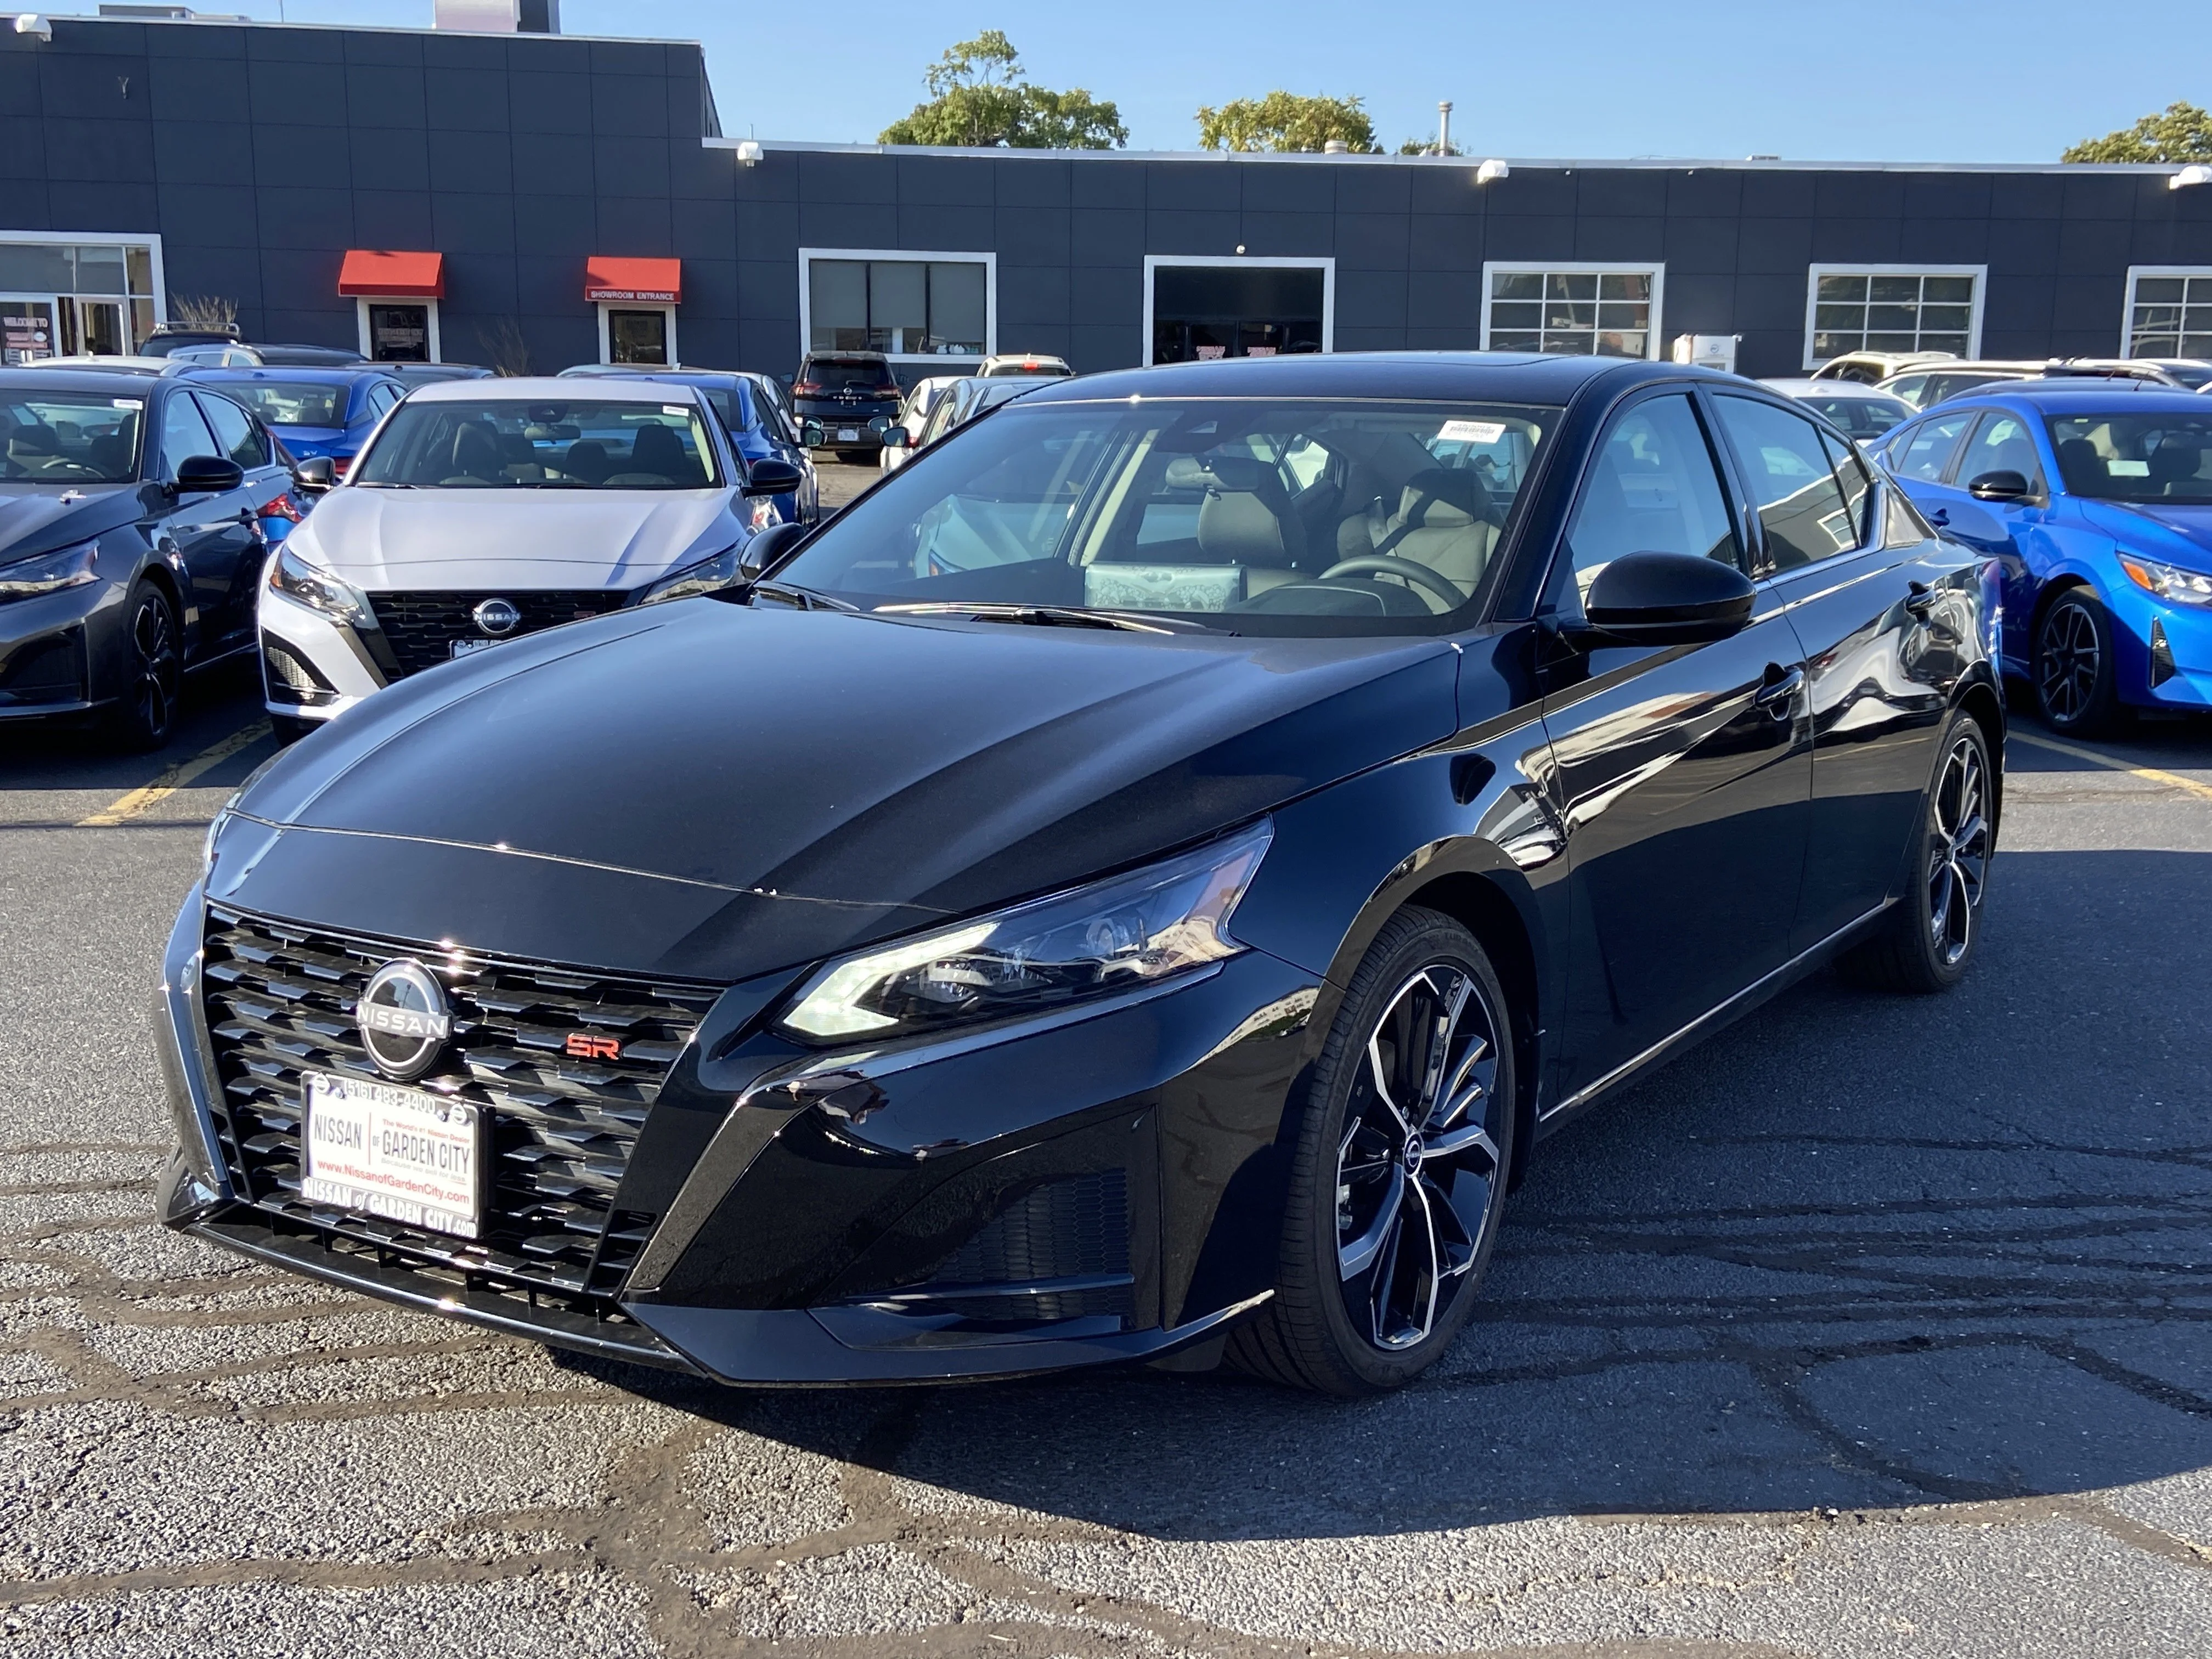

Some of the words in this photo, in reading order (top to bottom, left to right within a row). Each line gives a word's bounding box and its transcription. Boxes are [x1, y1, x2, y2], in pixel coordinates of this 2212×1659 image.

[591, 291, 634, 299] SHOWROOM
[637, 292, 674, 301] ENTRANCE
[357, 1005, 445, 1035] NISSAN
[566, 1032, 619, 1060] SR
[343, 1079, 372, 1100] (516)
[374, 1086, 437, 1114] 483-4400
[314, 1113, 362, 1150] NISSAN
[382, 1129, 435, 1167] GARDEN
[439, 1142, 471, 1174] CITY
[450, 1133, 470, 1144] Dealer
[317, 1159, 470, 1204] www.NissanofGardenCity.com
[302, 1178, 352, 1207] NISSAN
[356, 1192, 368, 1211] of
[369, 1194, 422, 1224] GARDEN
[425, 1209, 478, 1239] CITY.com
